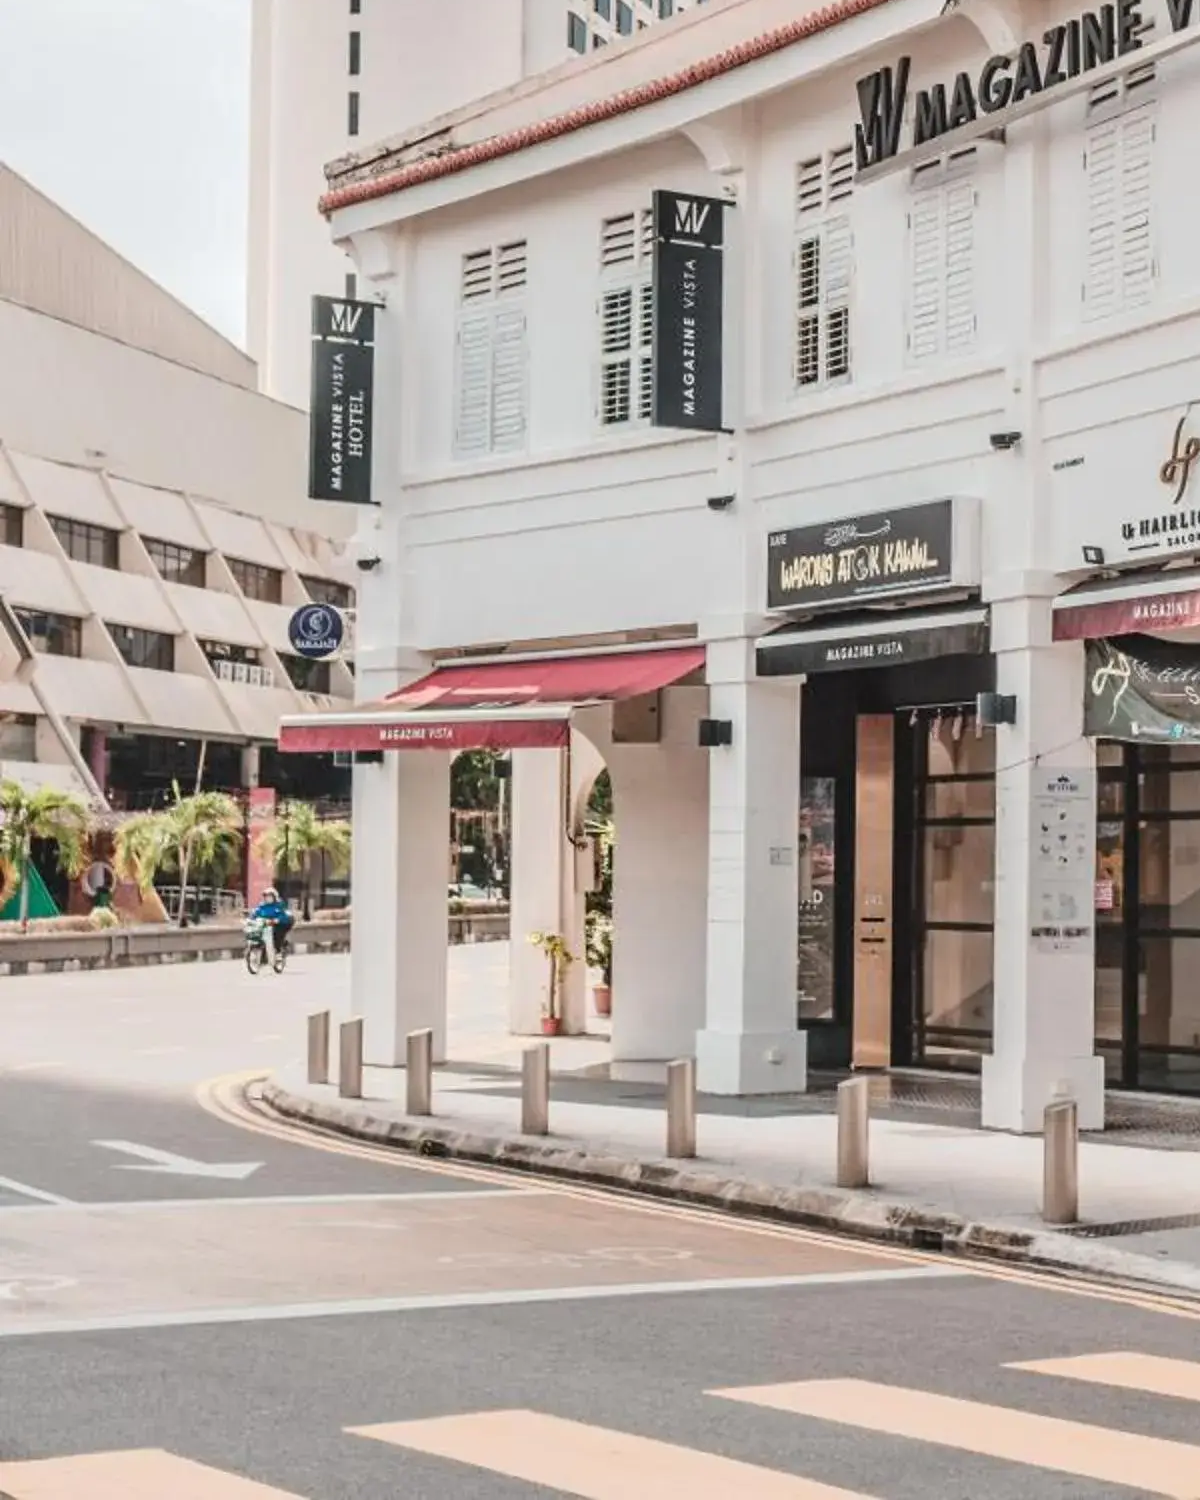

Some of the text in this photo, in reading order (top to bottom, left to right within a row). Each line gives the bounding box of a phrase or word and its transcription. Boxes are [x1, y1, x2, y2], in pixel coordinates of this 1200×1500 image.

[683, 259, 697, 416] MAGAZINE VISTA
[330, 353, 345, 491] MAGAZINE VISTA
[348, 391, 365, 457] HOTEL
[826, 641, 903, 661] MAGAZINE VISTA
